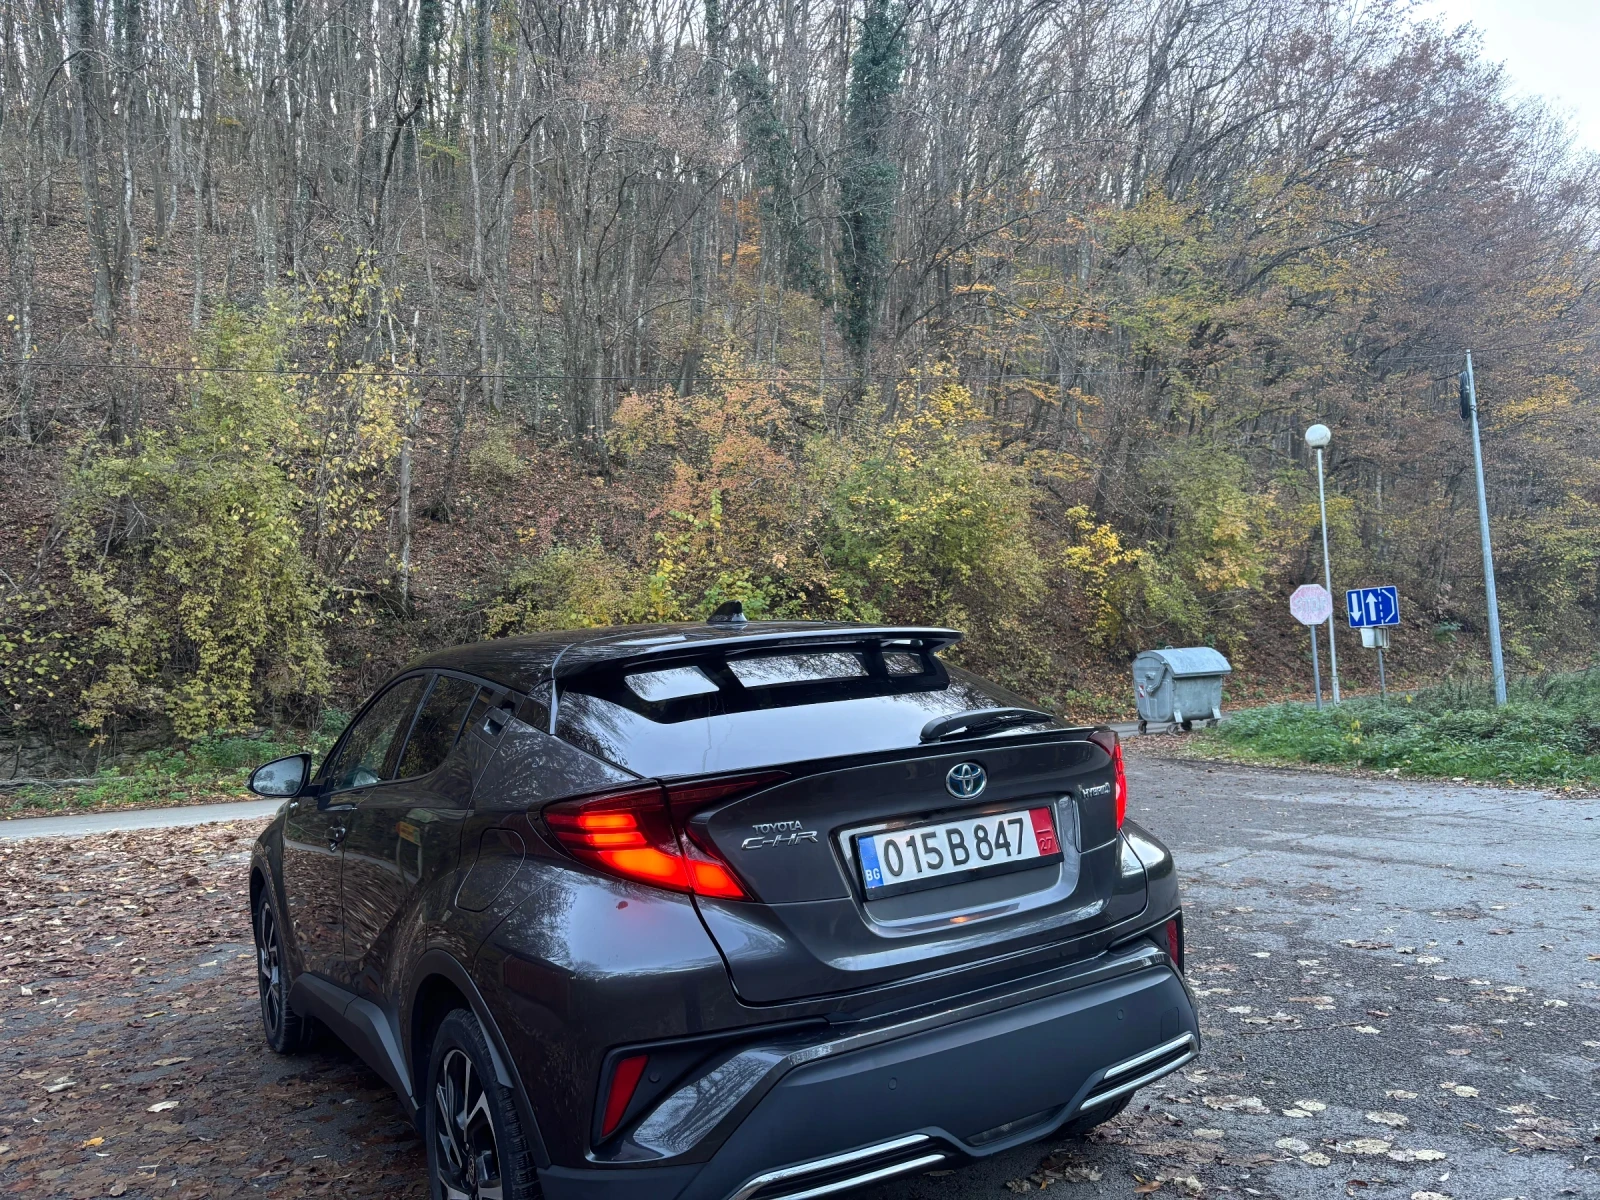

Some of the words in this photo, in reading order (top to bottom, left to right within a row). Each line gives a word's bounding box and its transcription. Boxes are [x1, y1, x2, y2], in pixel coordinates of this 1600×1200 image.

[1294, 597, 1328, 612] STOP
[752, 820, 803, 834] TOYOTA
[741, 831, 818, 850] C-HR
[1038, 836, 1053, 851] 27
[865, 868, 880, 881] BG
